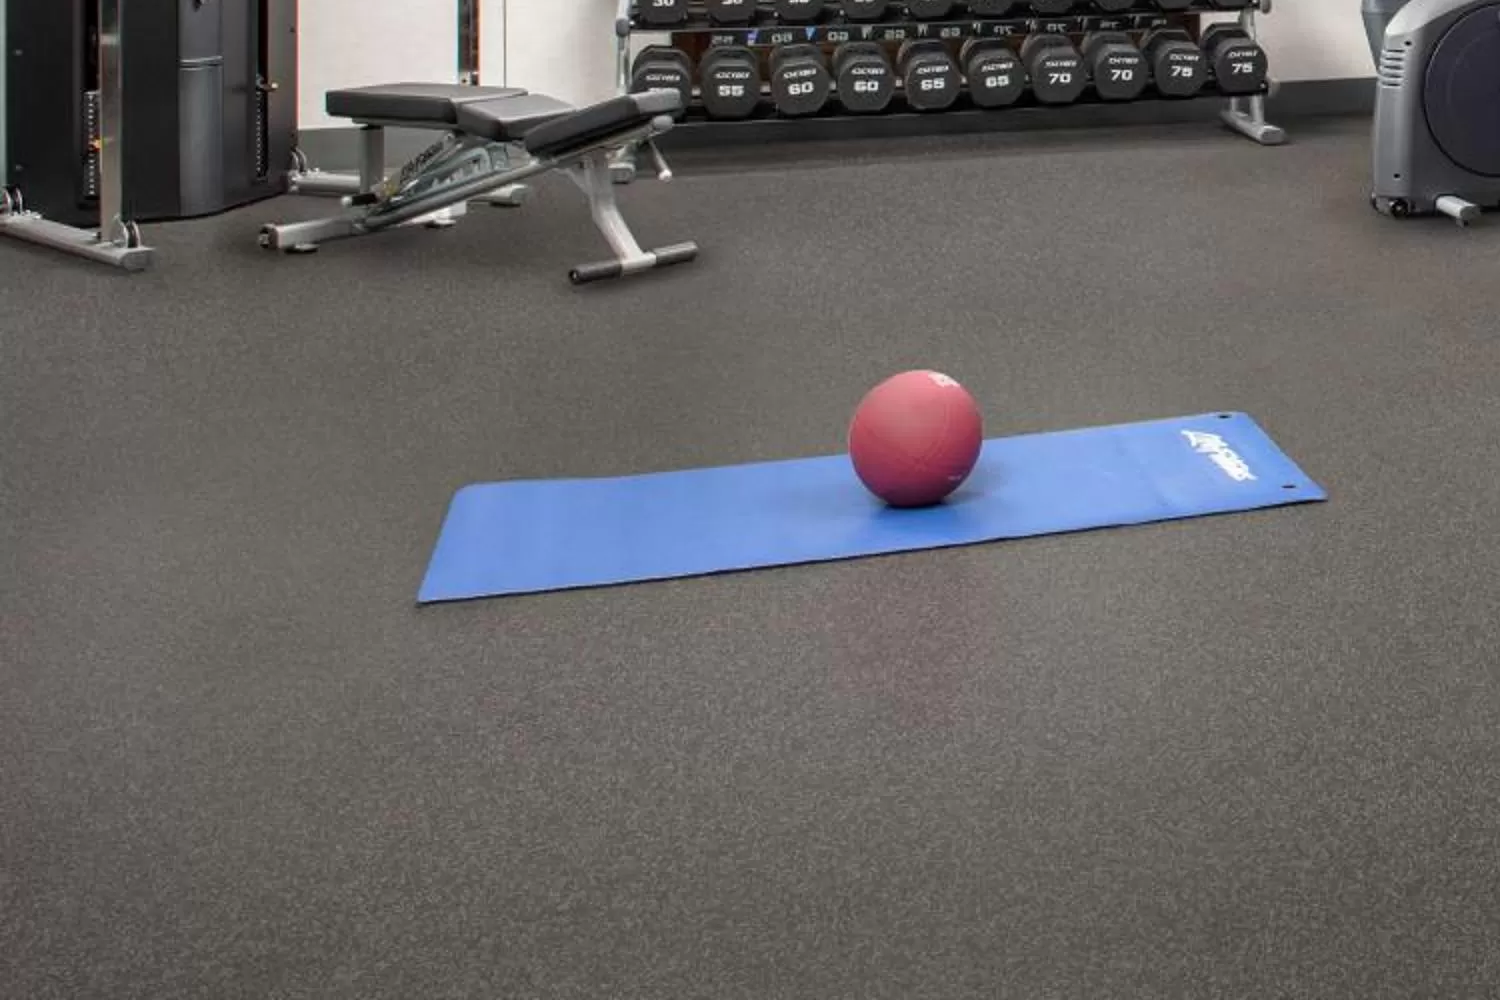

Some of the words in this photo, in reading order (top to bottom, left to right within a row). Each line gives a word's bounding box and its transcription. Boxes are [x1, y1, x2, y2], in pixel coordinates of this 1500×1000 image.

[1231, 62, 1253, 74] 75
[1048, 72, 1072, 85] 70
[1111, 69, 1133, 81] 70
[718, 84, 745, 97] 55
[787, 81, 815, 96] 60
[853, 79, 880, 92] 60
[920, 77, 945, 91] 65
